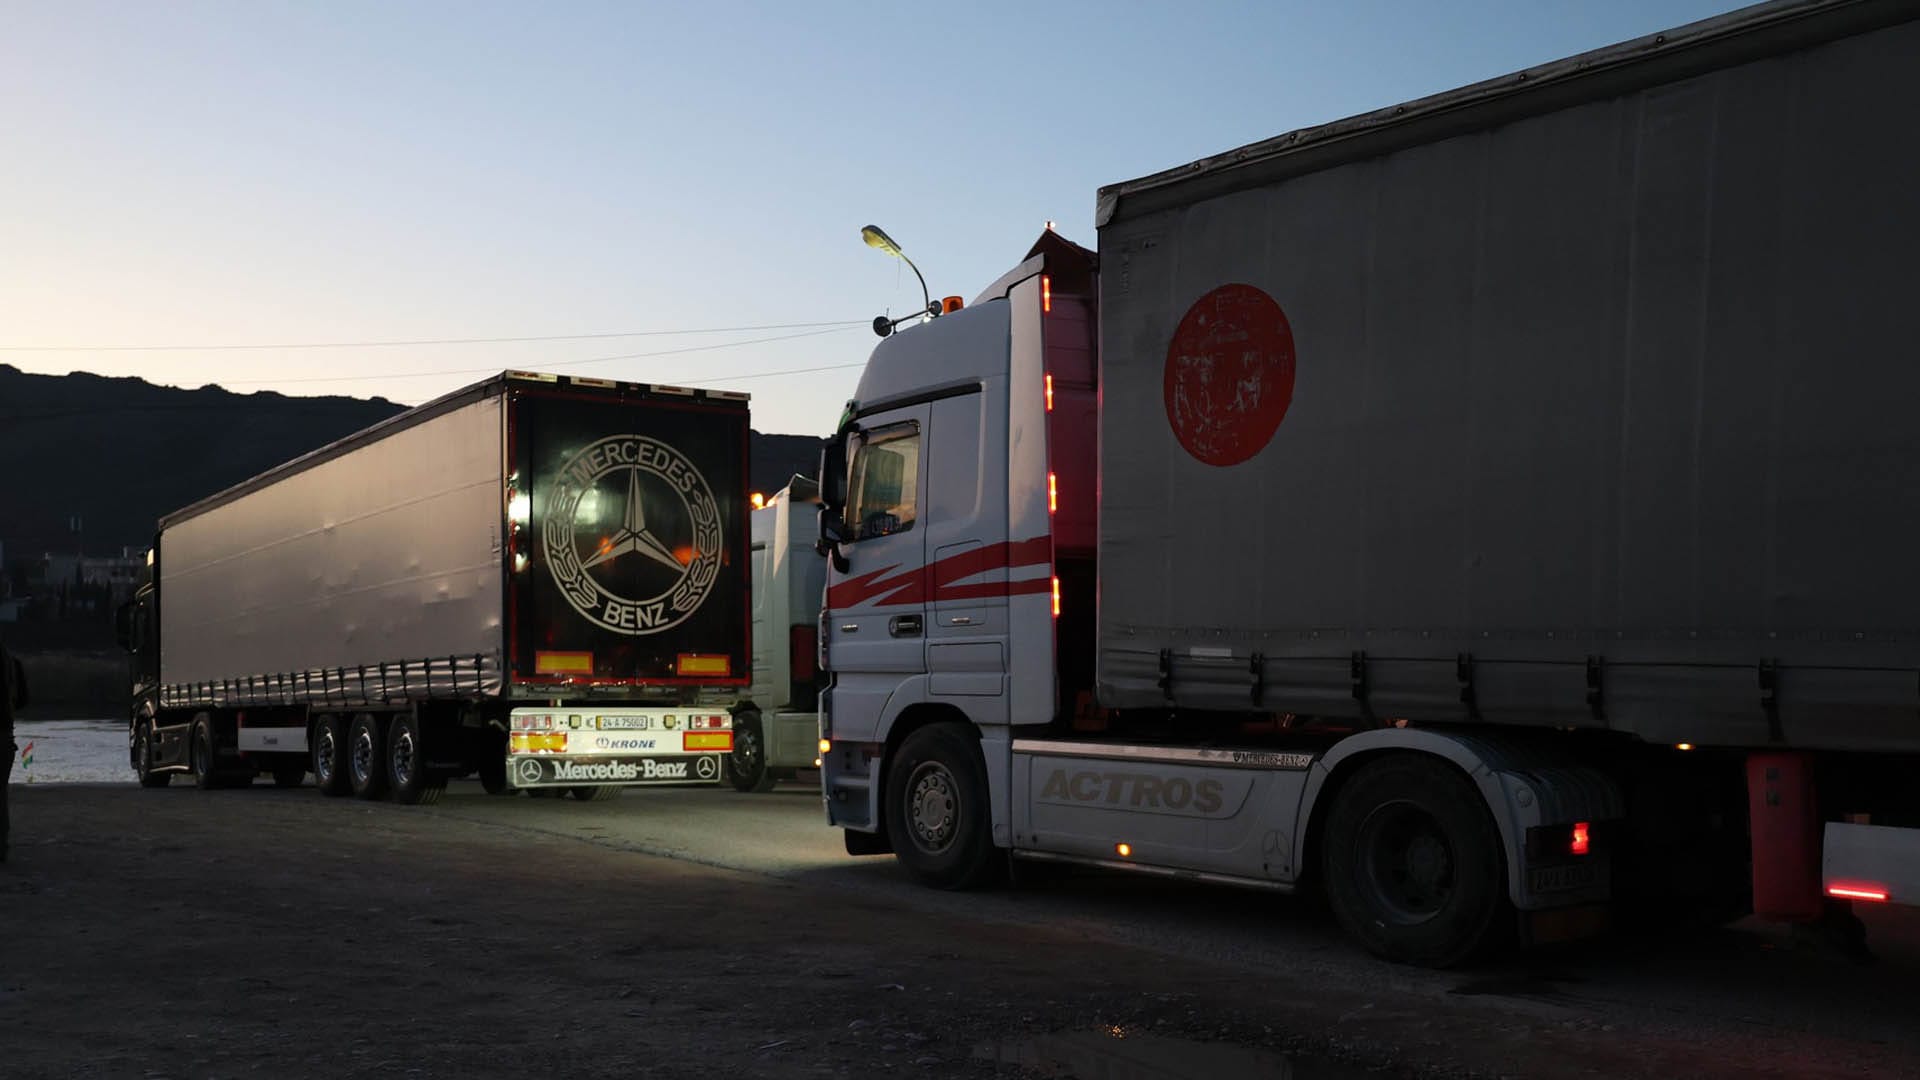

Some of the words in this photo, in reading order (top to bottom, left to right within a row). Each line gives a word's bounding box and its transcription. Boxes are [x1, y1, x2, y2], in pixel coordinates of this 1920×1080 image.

[571, 441, 696, 493] MERCEDES
[603, 601, 669, 628] BENZ
[603, 718, 612, 727] 24
[610, 740, 656, 749] KRONE
[552, 758, 688, 780] Mercedes-Benz
[1040, 768, 1224, 814] ACTROS
